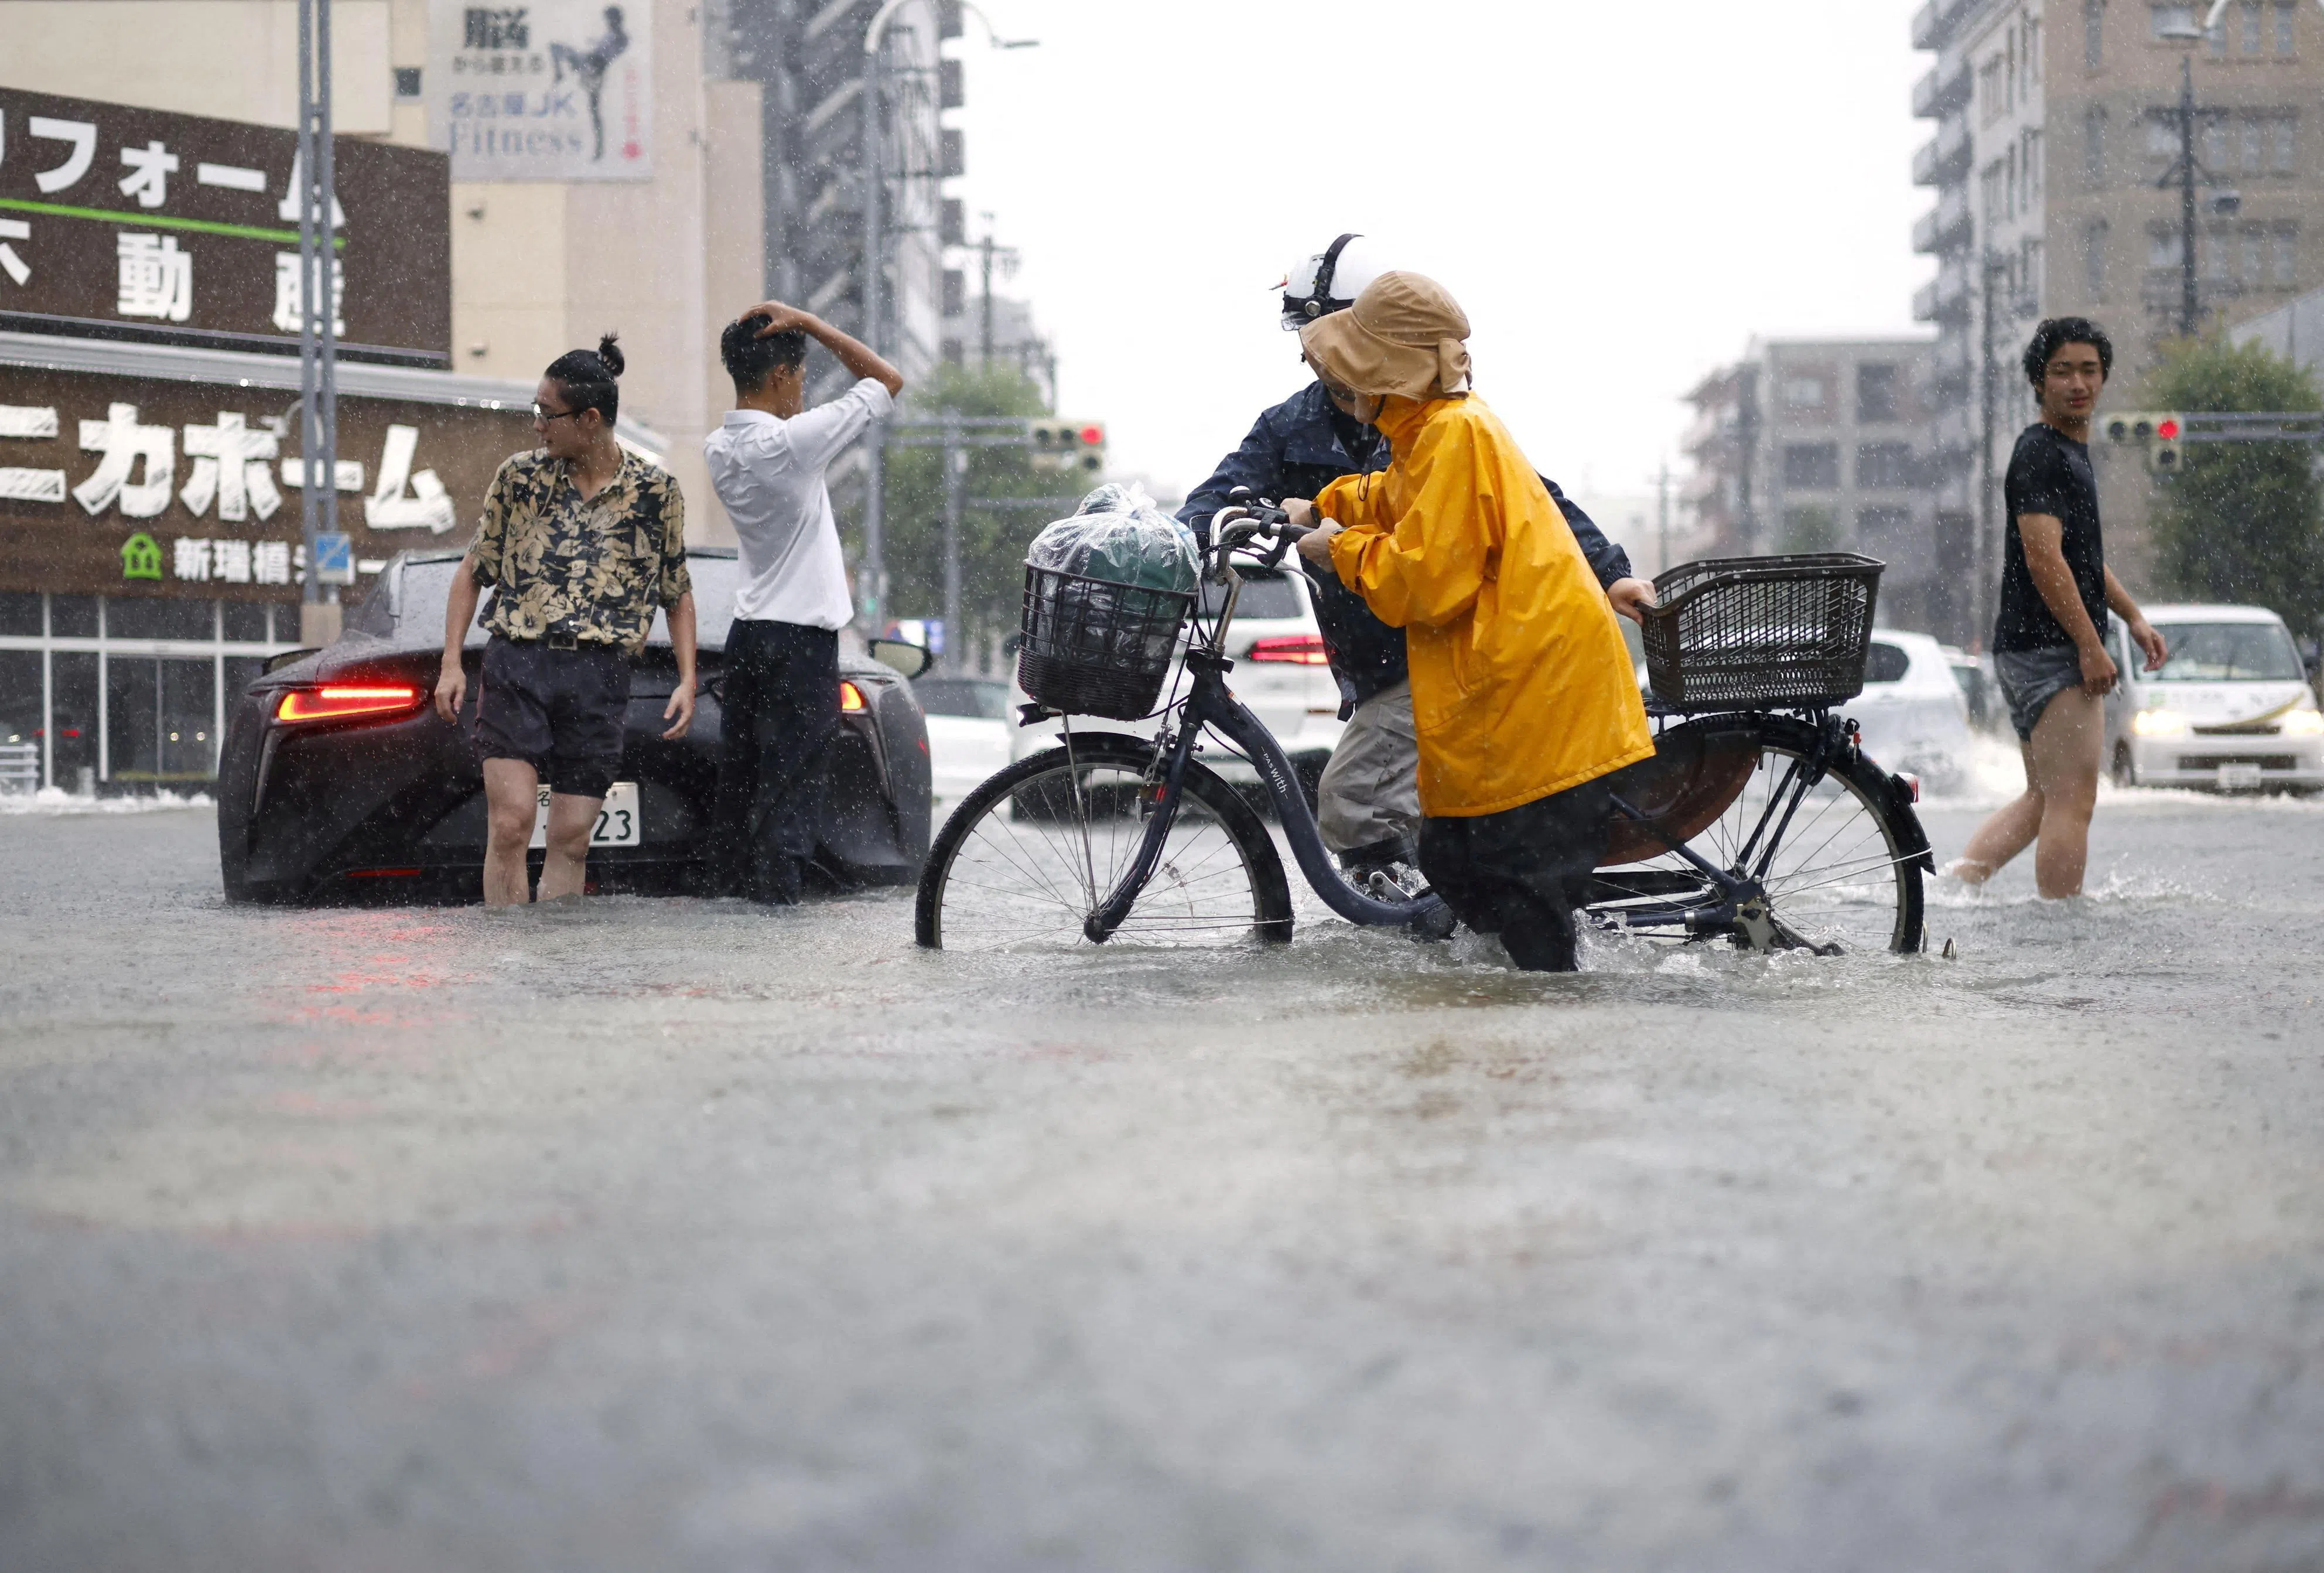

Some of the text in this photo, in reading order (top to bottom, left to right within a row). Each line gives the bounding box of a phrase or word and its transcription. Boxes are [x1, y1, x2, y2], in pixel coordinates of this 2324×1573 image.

[450, 121, 582, 156] Fitness
[0, 108, 346, 229] フォーム
[1264, 753, 1274, 768] PAS
